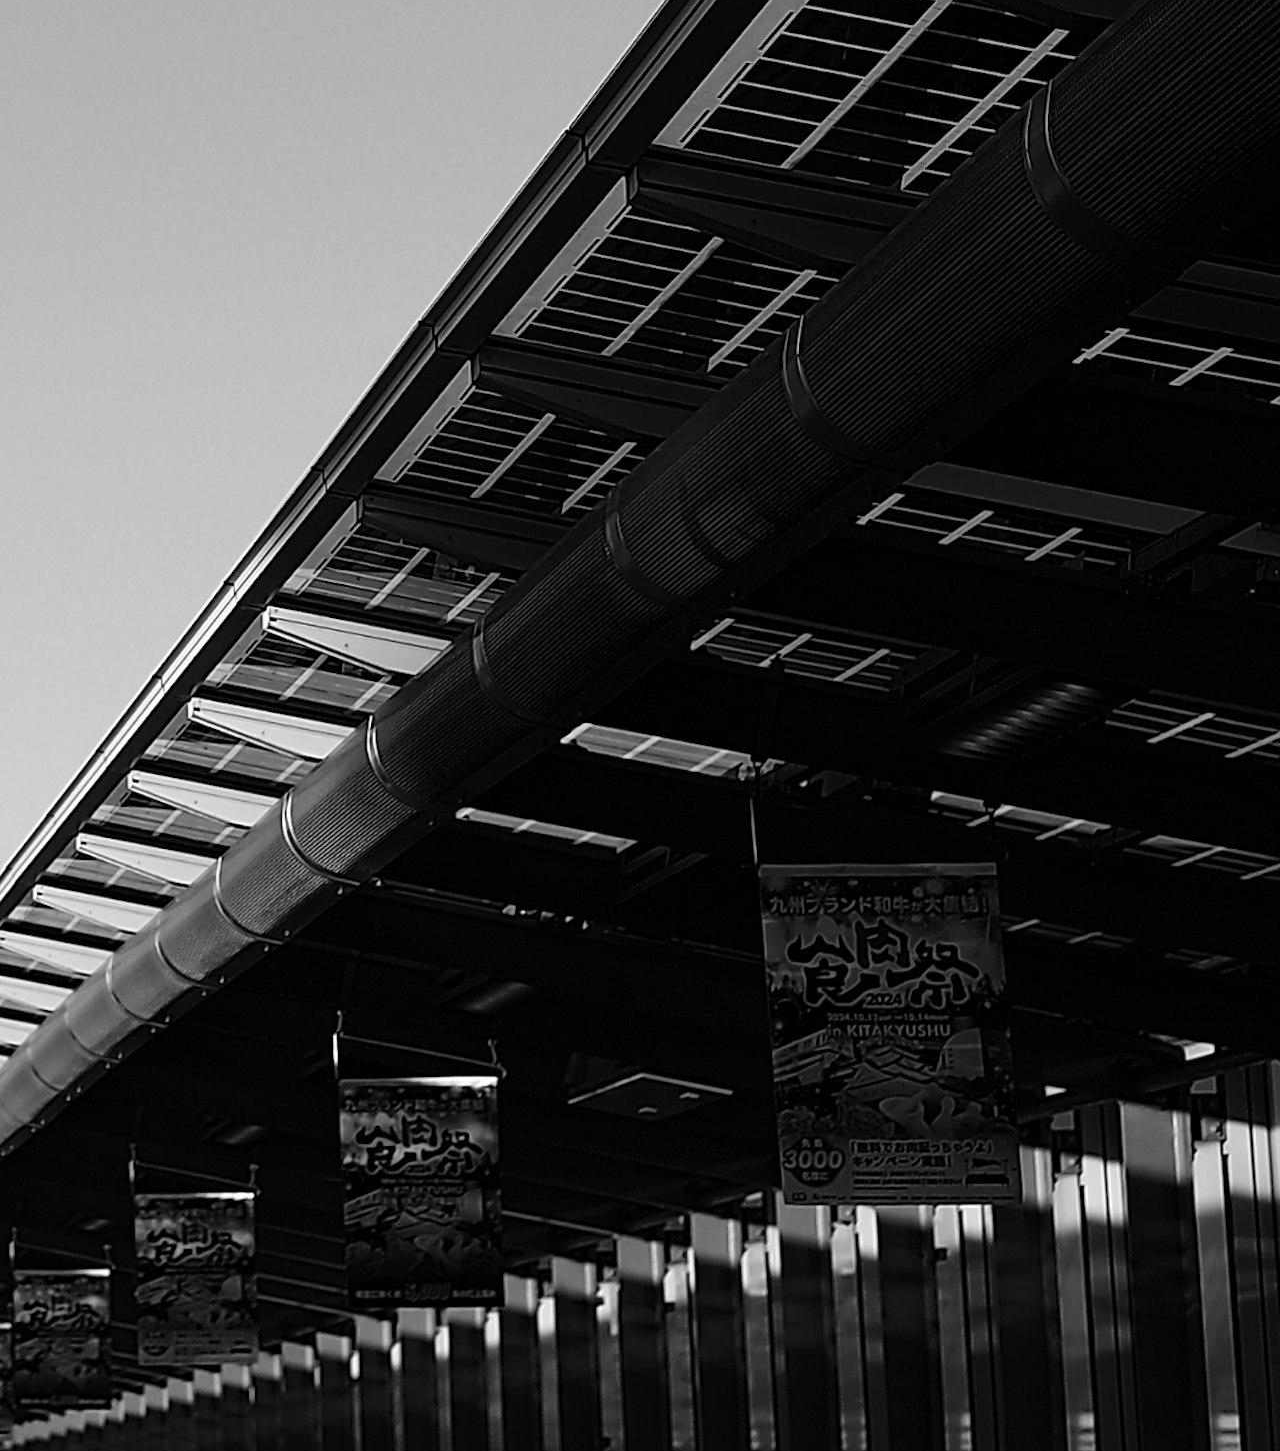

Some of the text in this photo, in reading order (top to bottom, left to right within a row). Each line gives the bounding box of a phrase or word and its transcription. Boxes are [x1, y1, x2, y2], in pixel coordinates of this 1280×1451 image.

[827, 1024, 951, 1037] in KITAKYUSHU
[783, 1150, 843, 1169] 3000
